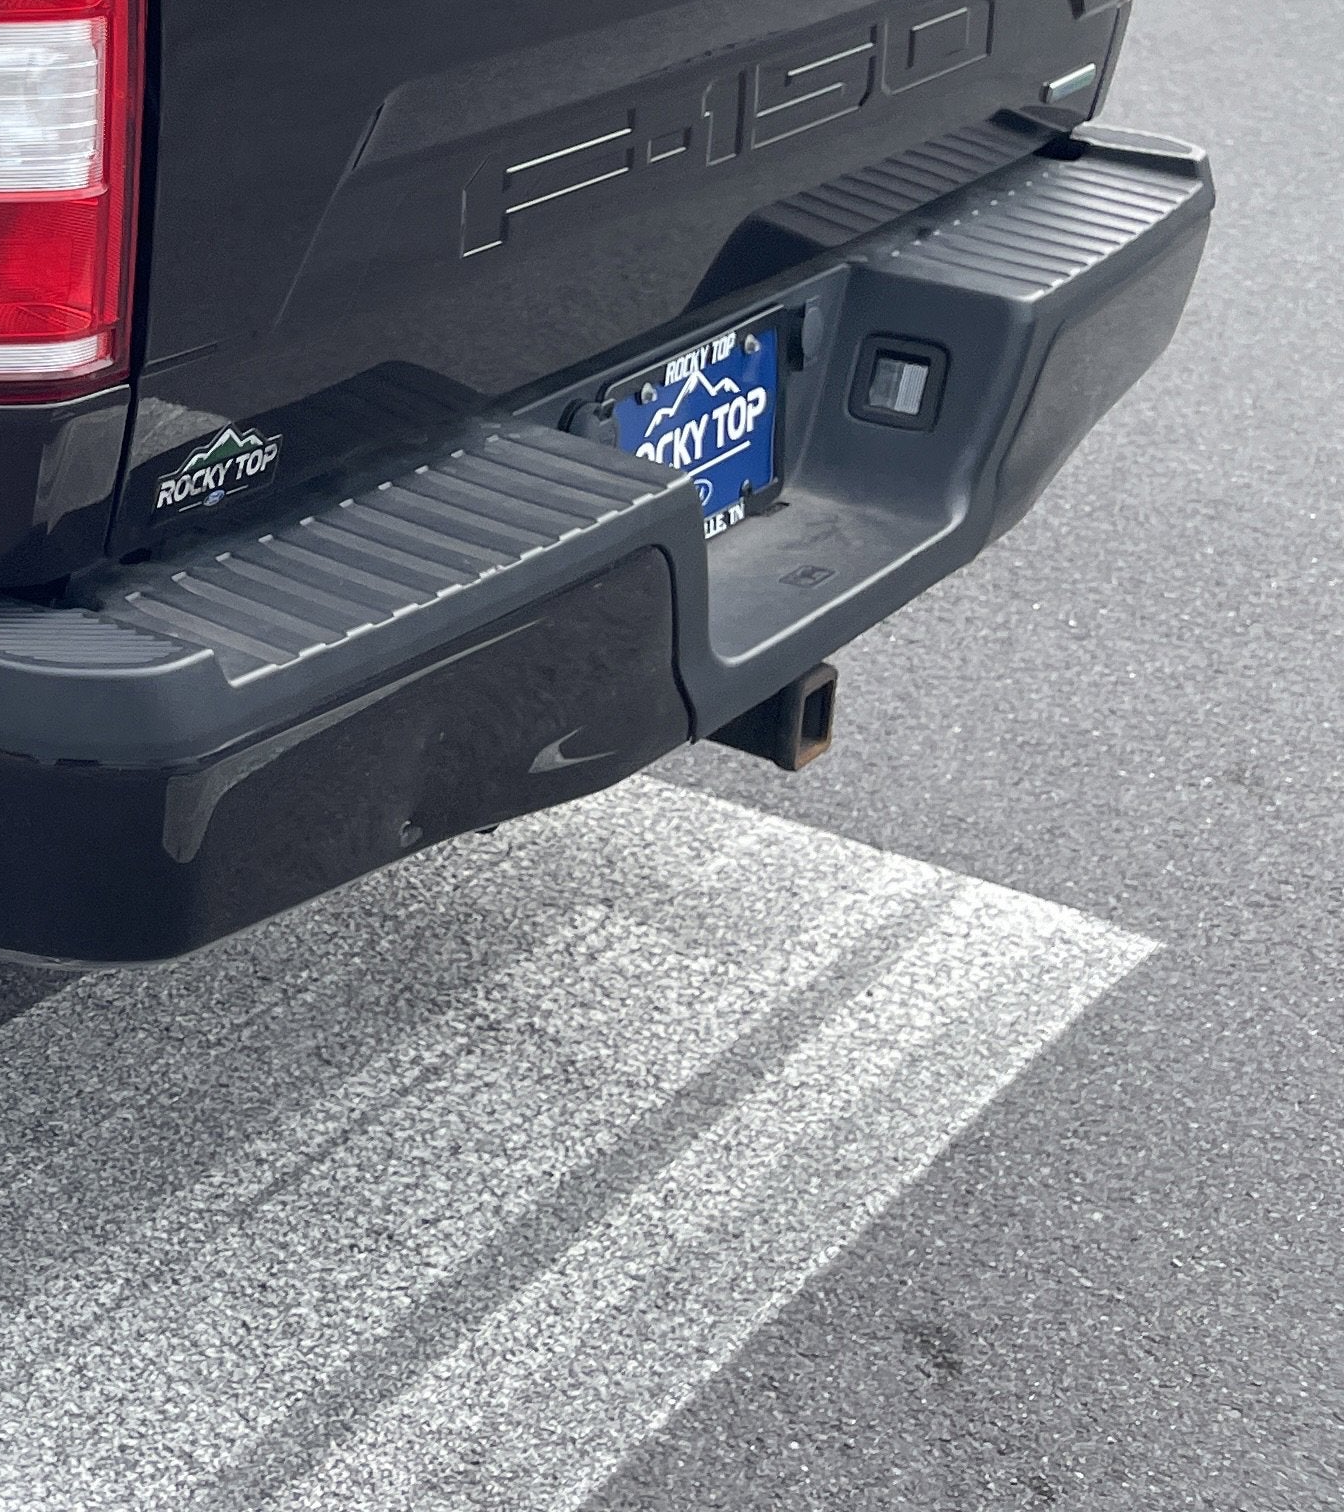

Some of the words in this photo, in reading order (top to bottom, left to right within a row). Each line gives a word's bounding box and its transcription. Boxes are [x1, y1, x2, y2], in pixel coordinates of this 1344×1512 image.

[664, 345, 710, 387] ROCKY
[712, 333, 737, 365] TOP
[635, 414, 709, 469] CKY
[712, 387, 767, 448] TOP
[156, 458, 233, 509] ROCKY
[236, 443, 278, 481] TOP
